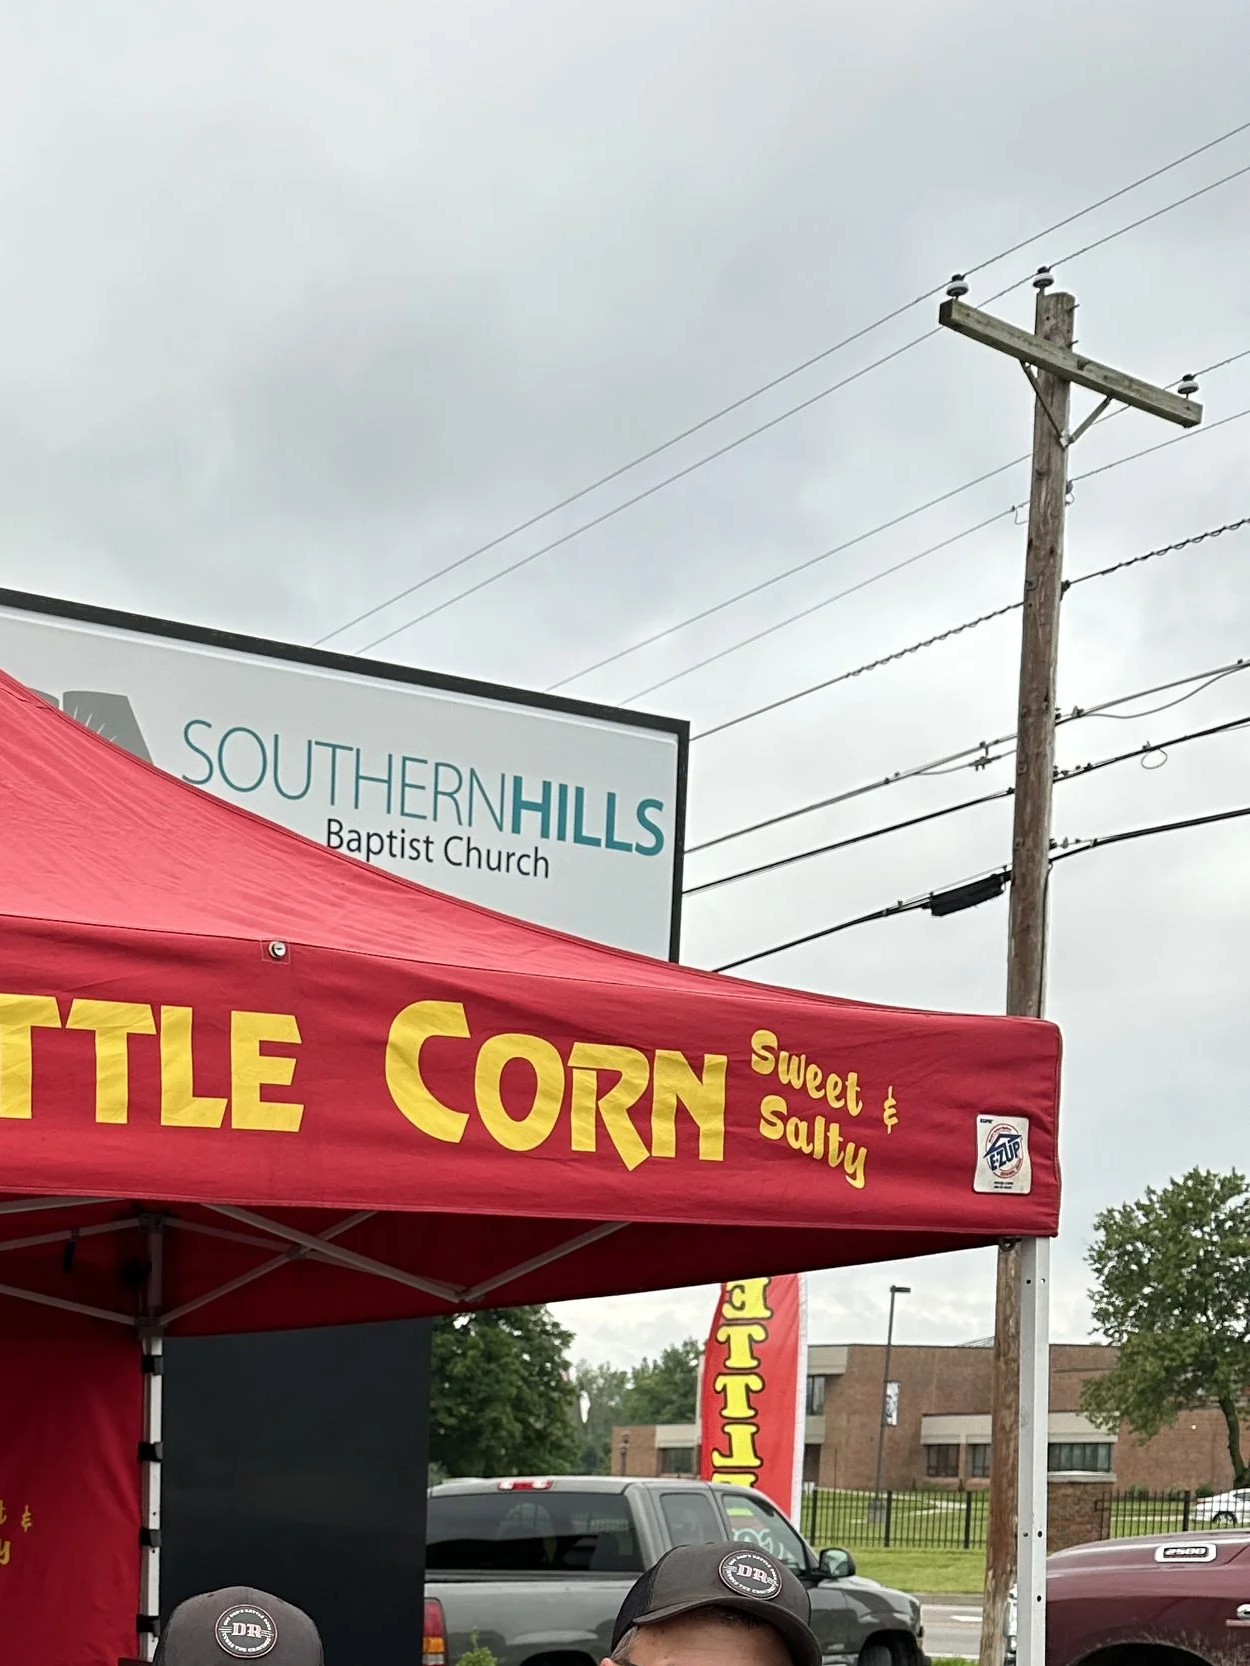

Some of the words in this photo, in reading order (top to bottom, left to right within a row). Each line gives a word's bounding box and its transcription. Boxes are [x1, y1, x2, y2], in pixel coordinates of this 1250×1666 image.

[181, 718, 665, 857] SOUTHERNHILLS
[325, 818, 435, 864] Baptist
[442, 833, 552, 880] Church
[384, 999, 729, 1172] CORN
[750, 1029, 864, 1119] Sweet
[882, 1085, 899, 1135] &
[759, 1094, 868, 1190] Salty
[736, 1564, 768, 1583] DR
[231, 1622, 262, 1638] DR
